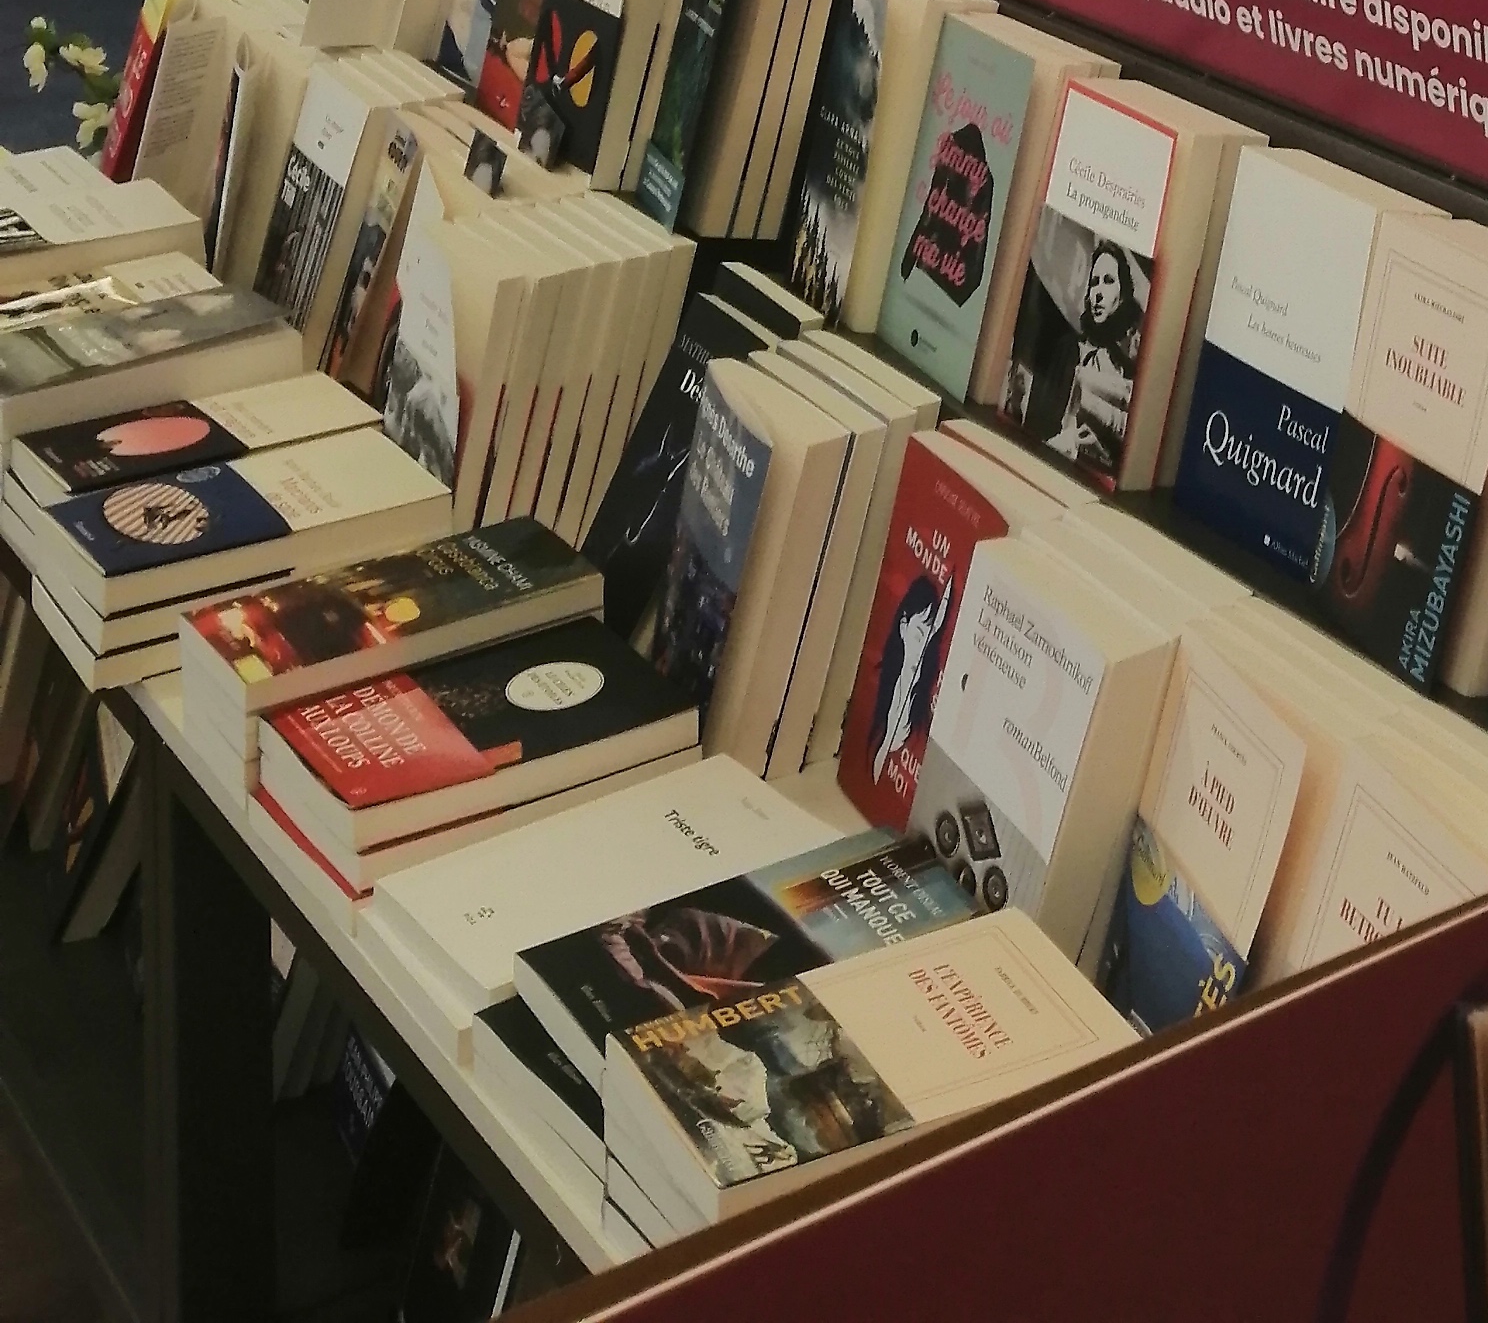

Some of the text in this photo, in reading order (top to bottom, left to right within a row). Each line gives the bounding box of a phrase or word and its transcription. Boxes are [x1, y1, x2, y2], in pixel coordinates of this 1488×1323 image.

[1236, 5, 1265, 39] et
[1268, 8, 1349, 71] livres
[1068, 156, 1096, 184] Cécile
[1066, 180, 1141, 233] La propagandiste
[1385, 346, 1468, 409] INOUBLIABLE
[1411, 333, 1449, 371] SUITE
[1203, 409, 1324, 510] Quignard
[1276, 405, 1331, 455] Pascal
[905, 525, 949, 585] MONDE
[931, 529, 952, 559] UN
[1408, 491, 1472, 683] MIZUBAYASHI
[972, 633, 1028, 691] vénéneuse
[977, 608, 1034, 668] La maison
[1396, 607, 1426, 673] AKIRA
[319, 726, 372, 770] LOUPS
[325, 693, 406, 770] LA COLLINE
[395, 733, 427, 756] DE
[1002, 716, 1070, 794] romanBelfond
[887, 757, 910, 795] MOI
[1208, 775, 1237, 816] PIED
[663, 808, 721, 858] Triste tigre
[819, 868, 907, 947] QUI MANQUE
[856, 868, 917, 925] TOUT CE
[630, 983, 806, 1054] HUMBERT
[907, 967, 992, 1061] DES FANTÔMES
[932, 963, 1014, 1049] L'EXPÉRIENCE
